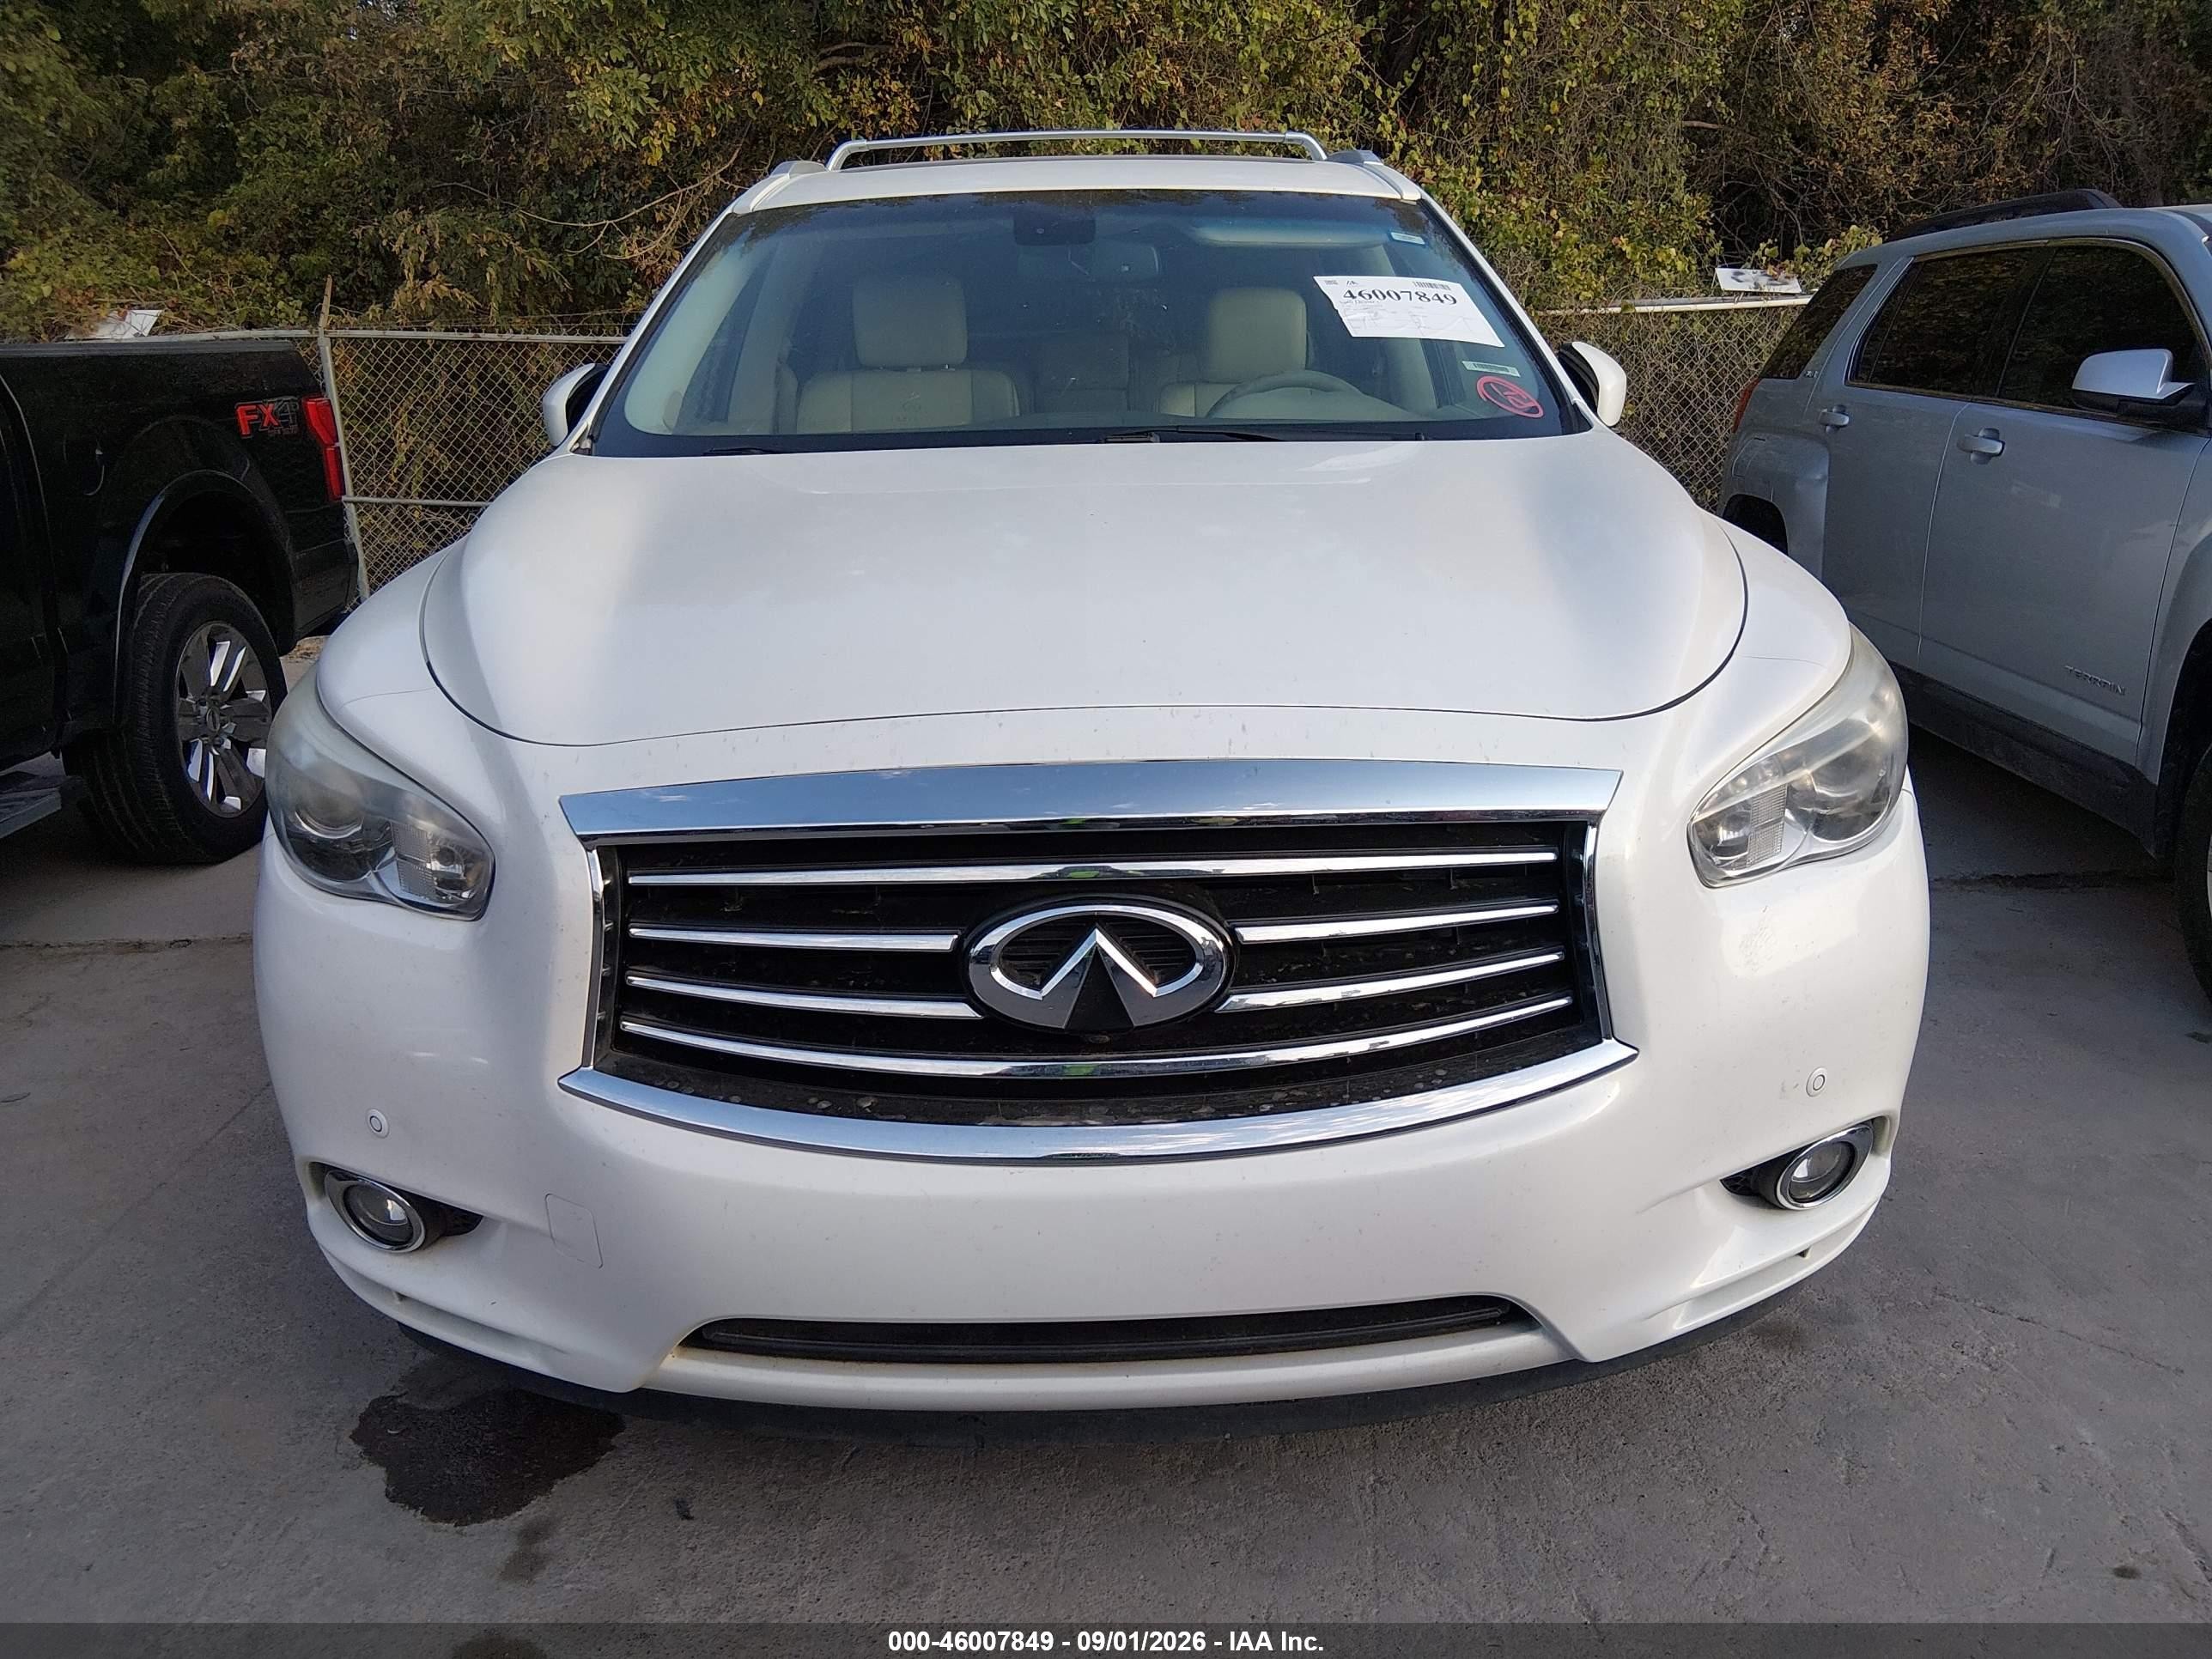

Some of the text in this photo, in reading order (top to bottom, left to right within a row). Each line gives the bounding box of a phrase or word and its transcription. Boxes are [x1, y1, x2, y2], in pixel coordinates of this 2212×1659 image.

[1342, 288, 1458, 306] 46007849
[235, 397, 299, 438] FX4
[2063, 665, 2126, 696] TERRAIN
